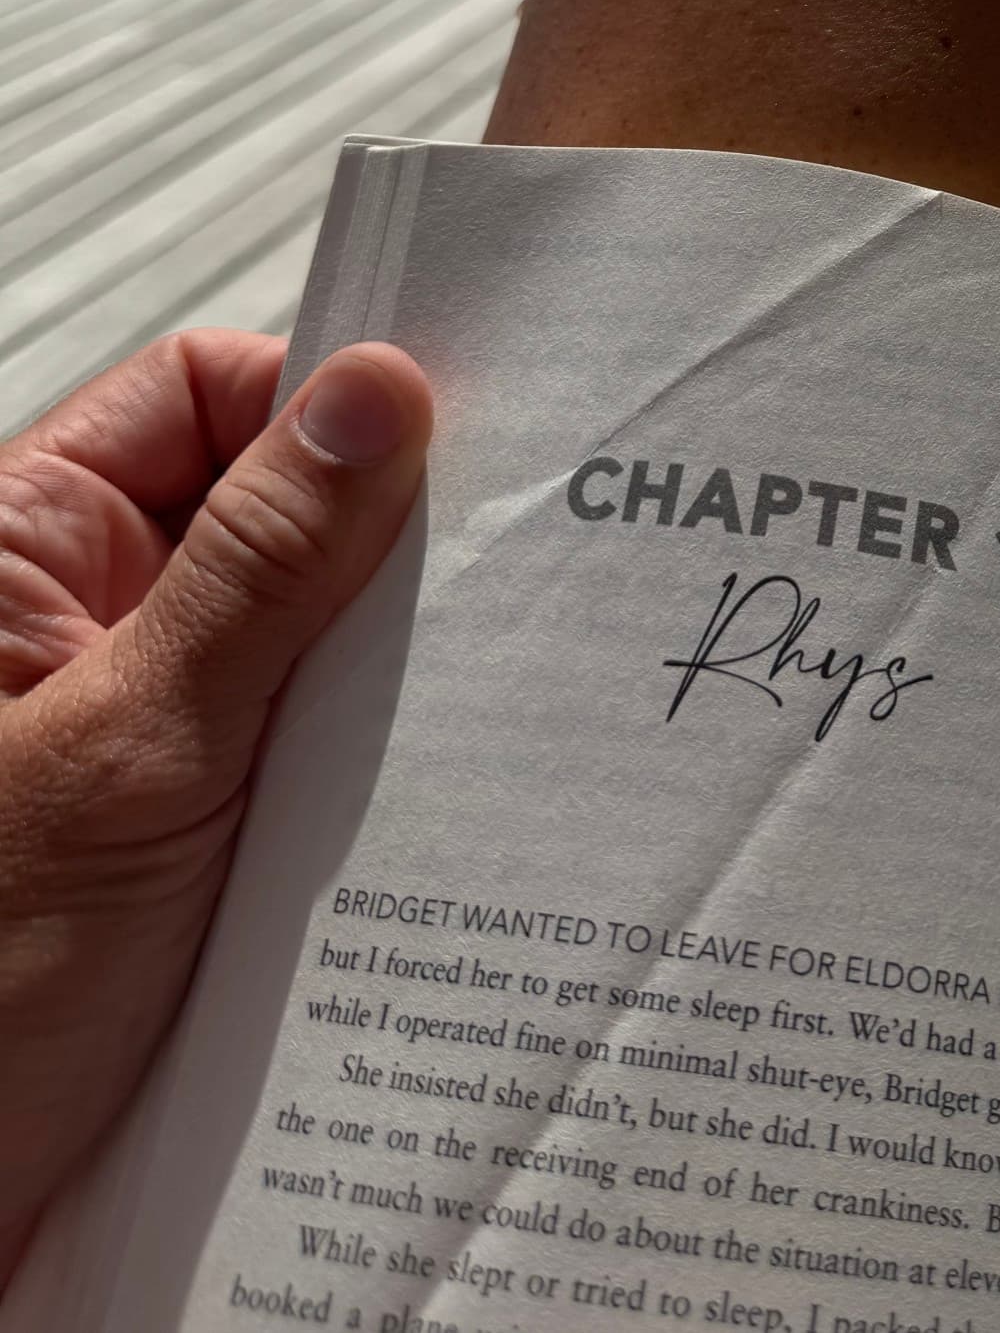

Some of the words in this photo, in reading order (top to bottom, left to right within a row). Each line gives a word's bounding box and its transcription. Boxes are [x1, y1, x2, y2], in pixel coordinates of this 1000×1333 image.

[566, 456, 960, 572] CHAPTER
[663, 572, 934, 742] Rhys
[318, 938, 363, 972] but
[364, 945, 381, 975] I
[382, 946, 465, 987] forced
[468, 957, 515, 993] her
[520, 972, 550, 998] to
[554, 979, 602, 1009] get
[607, 986, 683, 1016] some
[689, 989, 762, 1034] sleep
[769, 998, 836, 1039] first.
[848, 1011, 918, 1050] We’d
[924, 1021, 976, 1059] had
[982, 1041, 999, 1063] a
[332, 887, 459, 929] BRIDGET
[462, 903, 599, 948] WANTED
[607, 921, 654, 956] TO
[659, 928, 763, 971] LEAVE
[768, 944, 838, 982] FOR
[843, 954, 992, 1006] ELDORRA
[306, 993, 373, 1030] while
[376, 1002, 394, 1033] I
[395, 1016, 511, 1050] operated
[513, 1020, 568, 1058] fine
[573, 1039, 611, 1065] on
[618, 1037, 740, 1082] minimal
[745, 1053, 874, 1106] shut-eye,
[882, 1072, 983, 1120] Bridget
[337, 1053, 385, 1089] She
[390, 1060, 491, 1106] insisted
[492, 1076, 541, 1113] she
[544, 1083, 640, 1135] didn’t,
[648, 1096, 700, 1136] but
[704, 1106, 755, 1143] she
[761, 1114, 819, 1151] did.
[825, 1122, 842, 1154] I
[847, 1132, 938, 1168] would
[275, 1101, 317, 1137] the
[327, 1119, 376, 1147] one
[385, 1128, 421, 1155] on
[433, 1127, 478, 1163] the
[489, 1145, 620, 1192] receiving
[631, 1160, 690, 1194] end
[701, 1167, 740, 1200] of
[748, 1170, 802, 1209] her
[812, 1188, 972, 1231] crankiness.
